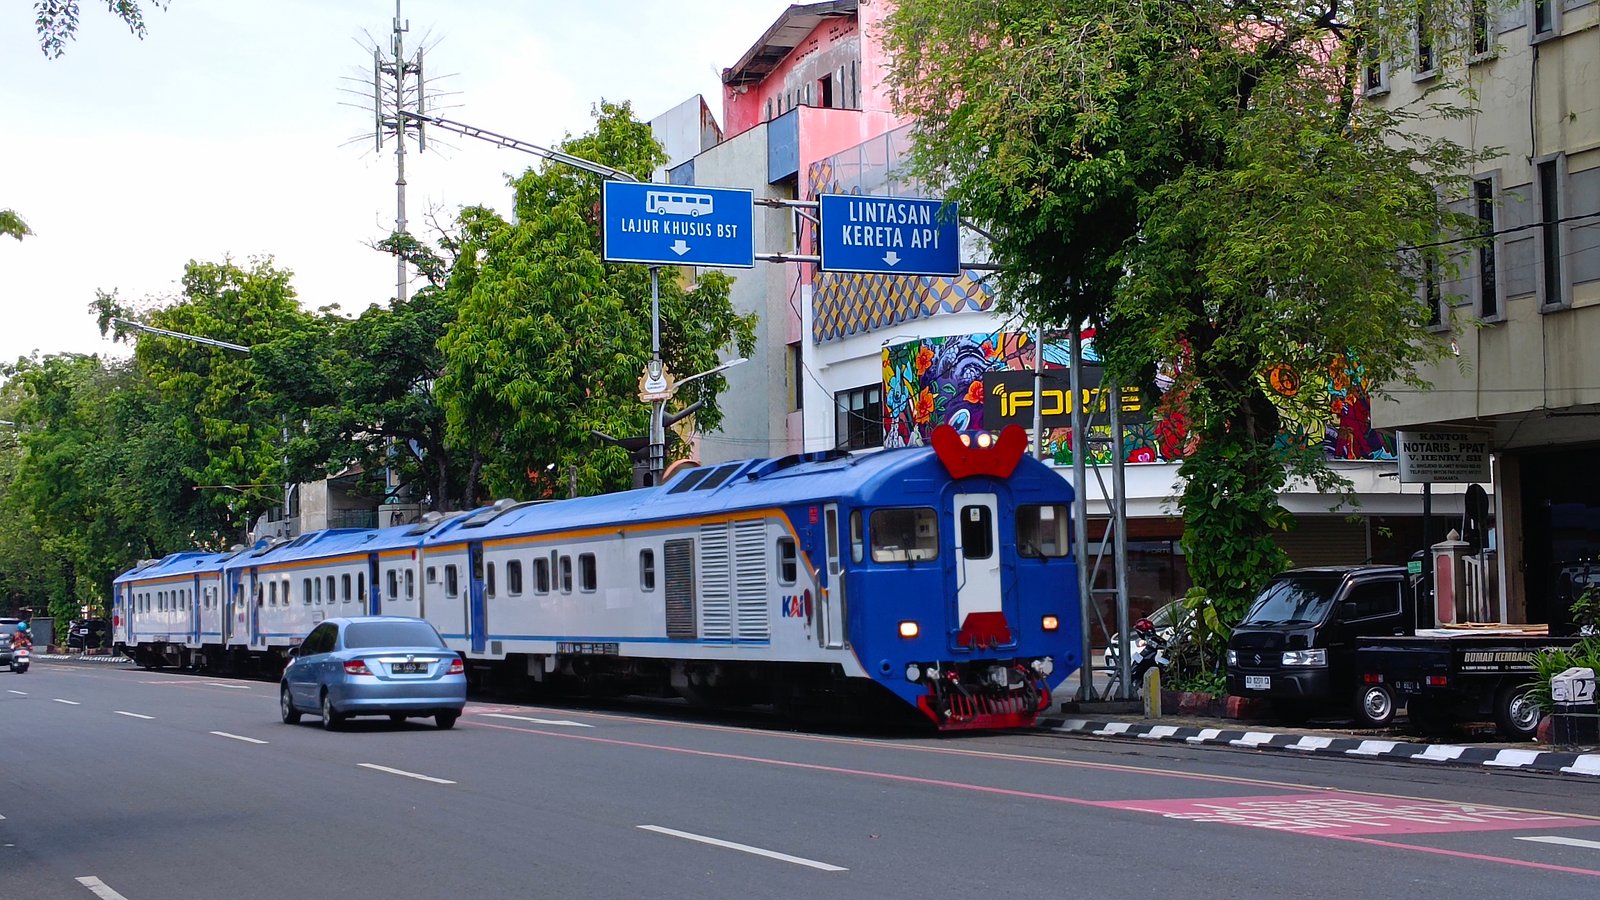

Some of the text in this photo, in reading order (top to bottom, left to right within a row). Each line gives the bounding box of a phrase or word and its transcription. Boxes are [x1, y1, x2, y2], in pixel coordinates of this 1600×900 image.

[849, 201, 931, 226] LINTASAN
[621, 218, 738, 239] LAJUR KHUSUS BST
[842, 225, 939, 249] KERETA API
[1403, 443, 1450, 452] NOTARIS
[1459, 443, 1486, 453] PPAT
[1420, 433, 1469, 441] KANTOR
[782, 595, 804, 618] KAI
